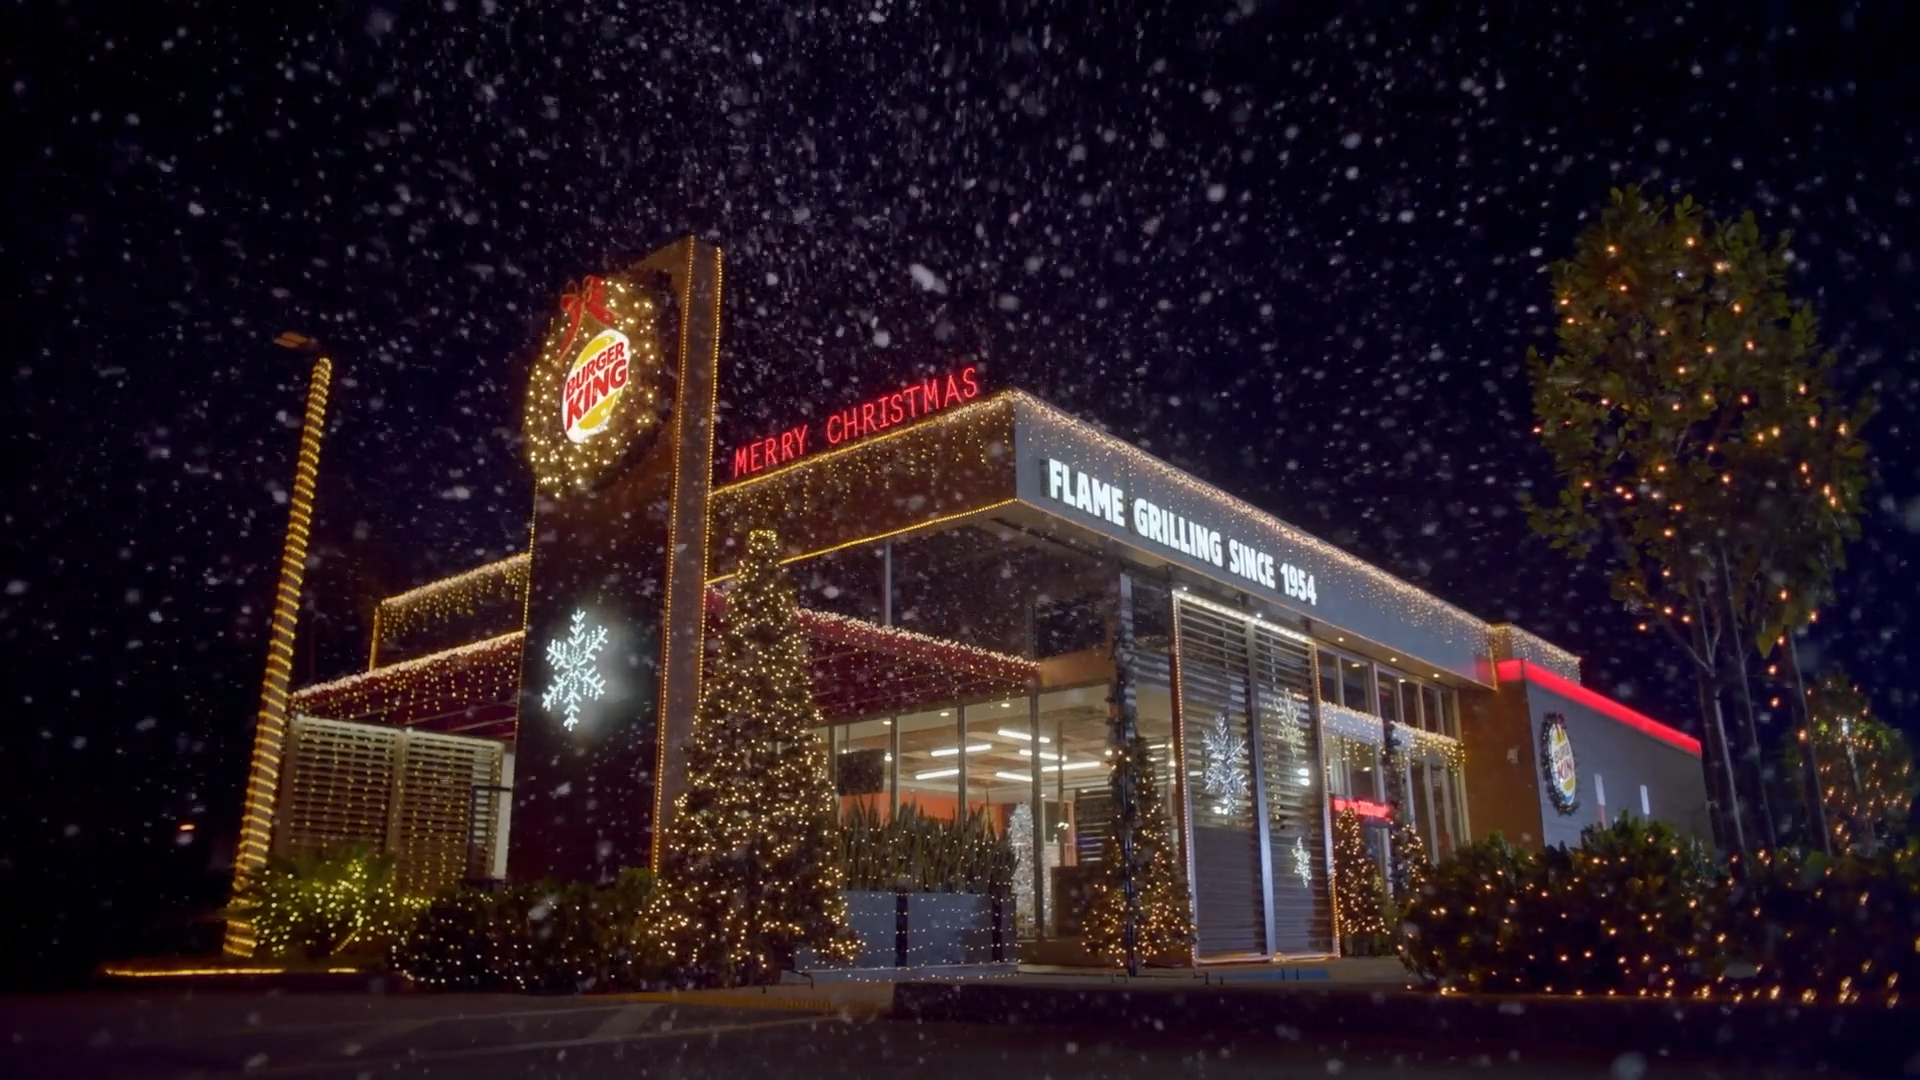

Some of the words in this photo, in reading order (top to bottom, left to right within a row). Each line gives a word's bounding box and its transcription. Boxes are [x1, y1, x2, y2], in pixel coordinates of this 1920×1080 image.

[565, 341, 625, 397] BURGER
[566, 359, 628, 431] KING
[734, 424, 808, 477] MERRY
[827, 367, 977, 444] CHRISTMAS
[1049, 458, 1125, 527] FLAME
[1133, 498, 1223, 567] GRILLING
[1228, 539, 1276, 589] SINCE
[1280, 562, 1317, 605] 1954
